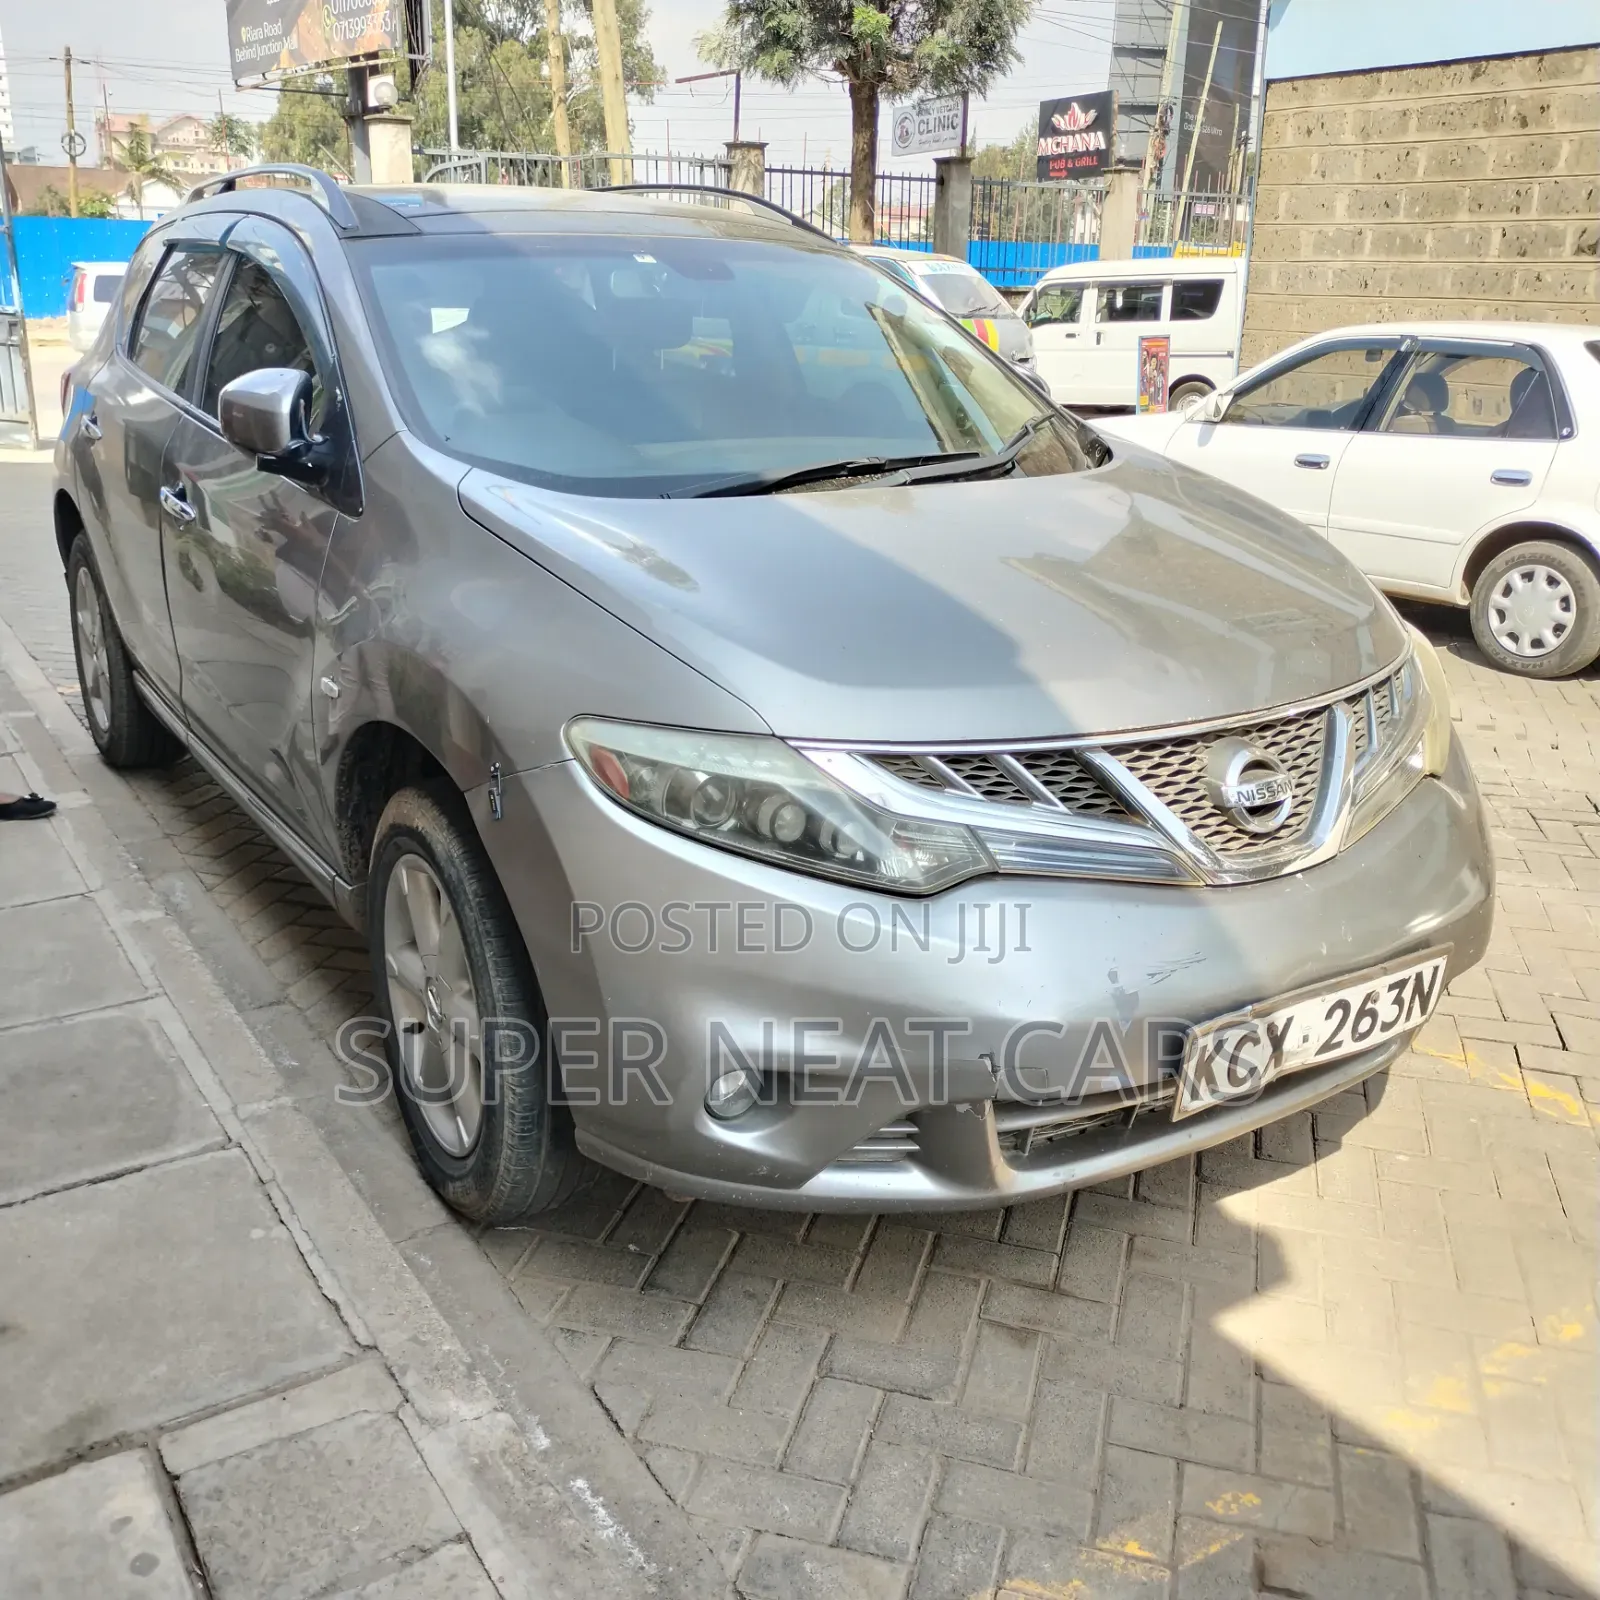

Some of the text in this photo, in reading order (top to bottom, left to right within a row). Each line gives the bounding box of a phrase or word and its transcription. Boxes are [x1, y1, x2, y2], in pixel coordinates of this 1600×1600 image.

[246, 18, 282, 42] Riara Road
[235, 44, 256, 63] Behind
[257, 39, 282, 61] Junction
[918, 113, 959, 135] CLINIC
[1185, 111, 1194, 120] The
[1037, 131, 1106, 156] MCHANA
[1050, 156, 1098, 169] PUB & GRILL
[1237, 780, 1293, 803] NISSAN
[1314, 965, 1440, 1057] 263N
